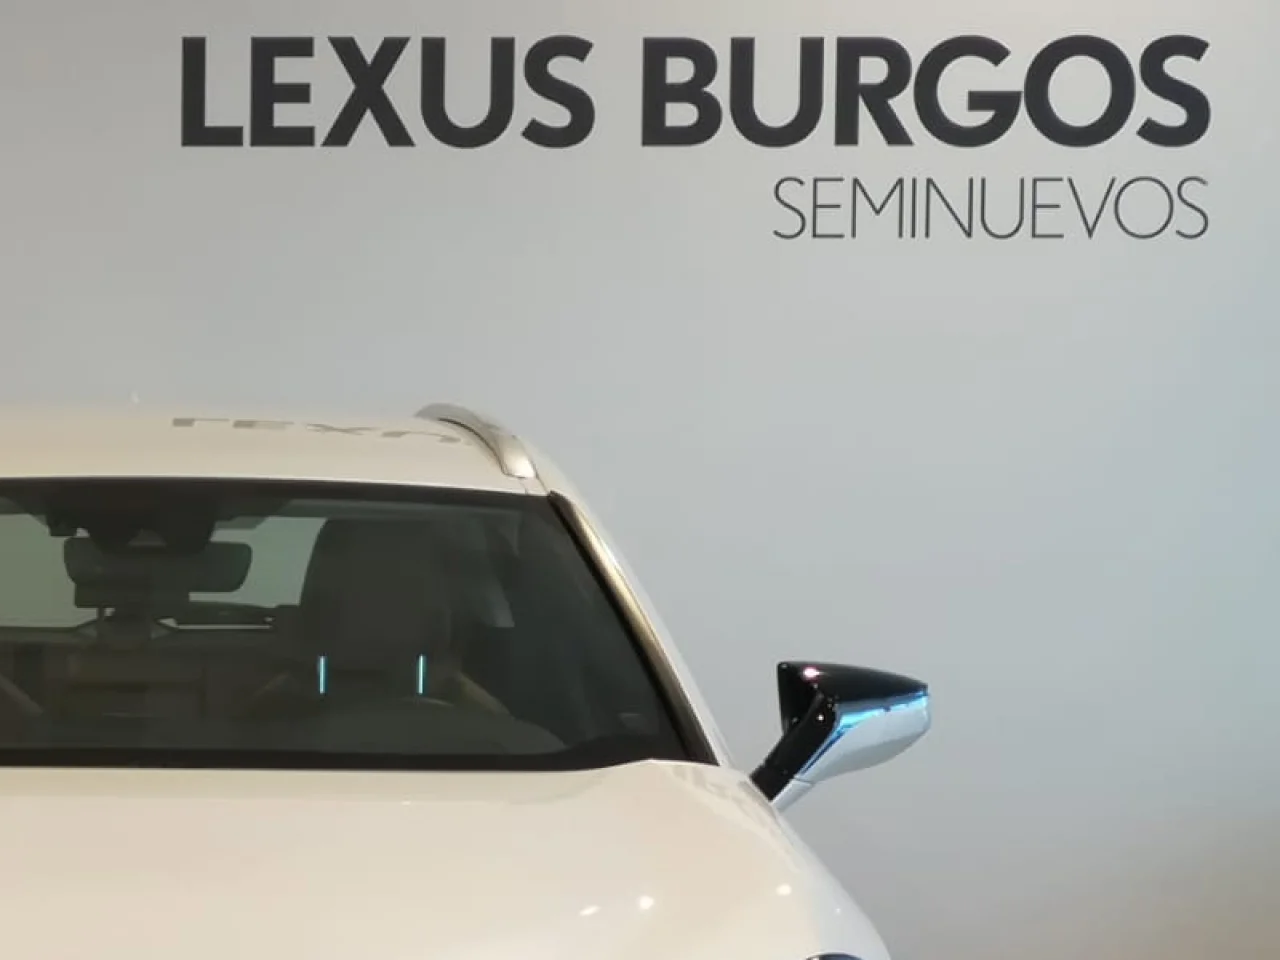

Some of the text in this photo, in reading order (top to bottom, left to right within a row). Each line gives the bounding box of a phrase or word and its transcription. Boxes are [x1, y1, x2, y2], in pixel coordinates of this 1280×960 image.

[181, 35, 1211, 150] LEXUS BURGOS
[773, 175, 1209, 240] SEMINUEVOS
